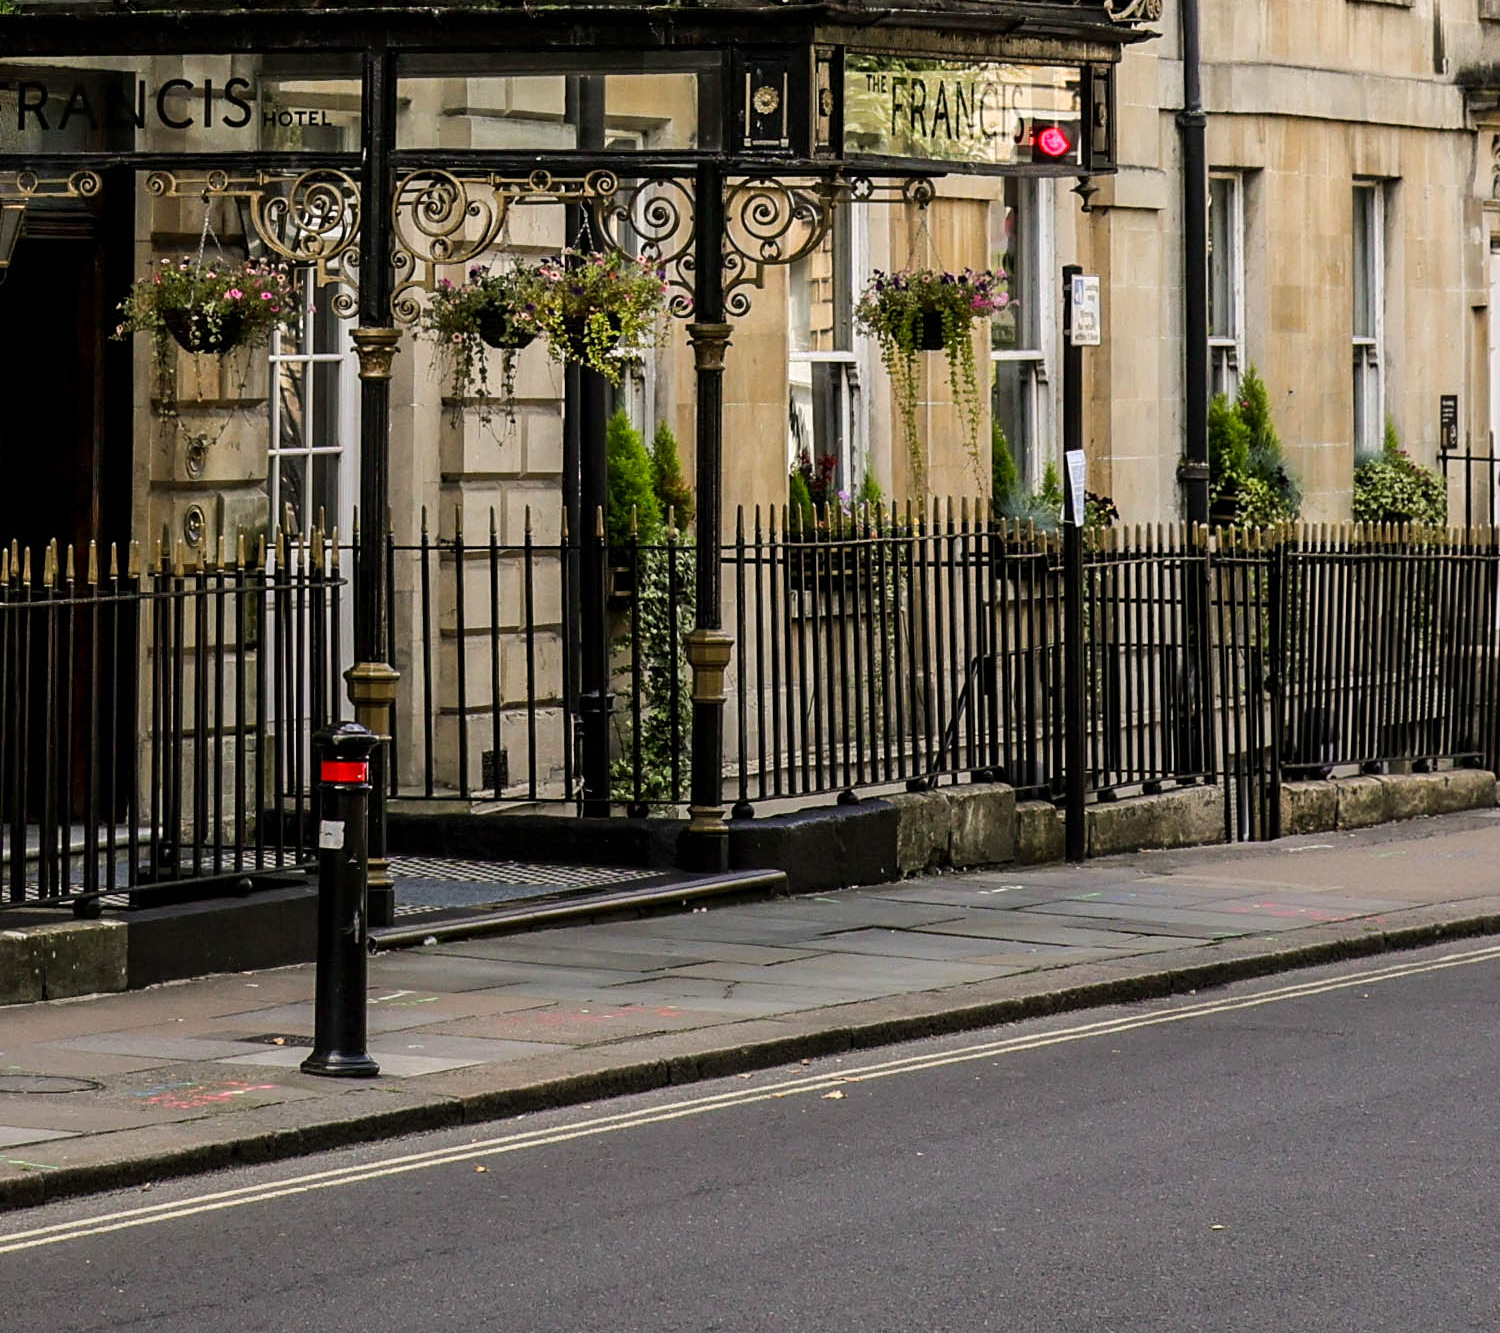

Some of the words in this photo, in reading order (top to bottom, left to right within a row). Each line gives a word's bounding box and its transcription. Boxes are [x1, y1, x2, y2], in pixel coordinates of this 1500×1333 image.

[865, 73, 887, 94] THE
[263, 110, 332, 128] HOTEL
[891, 76, 1025, 145] FRANCIS
